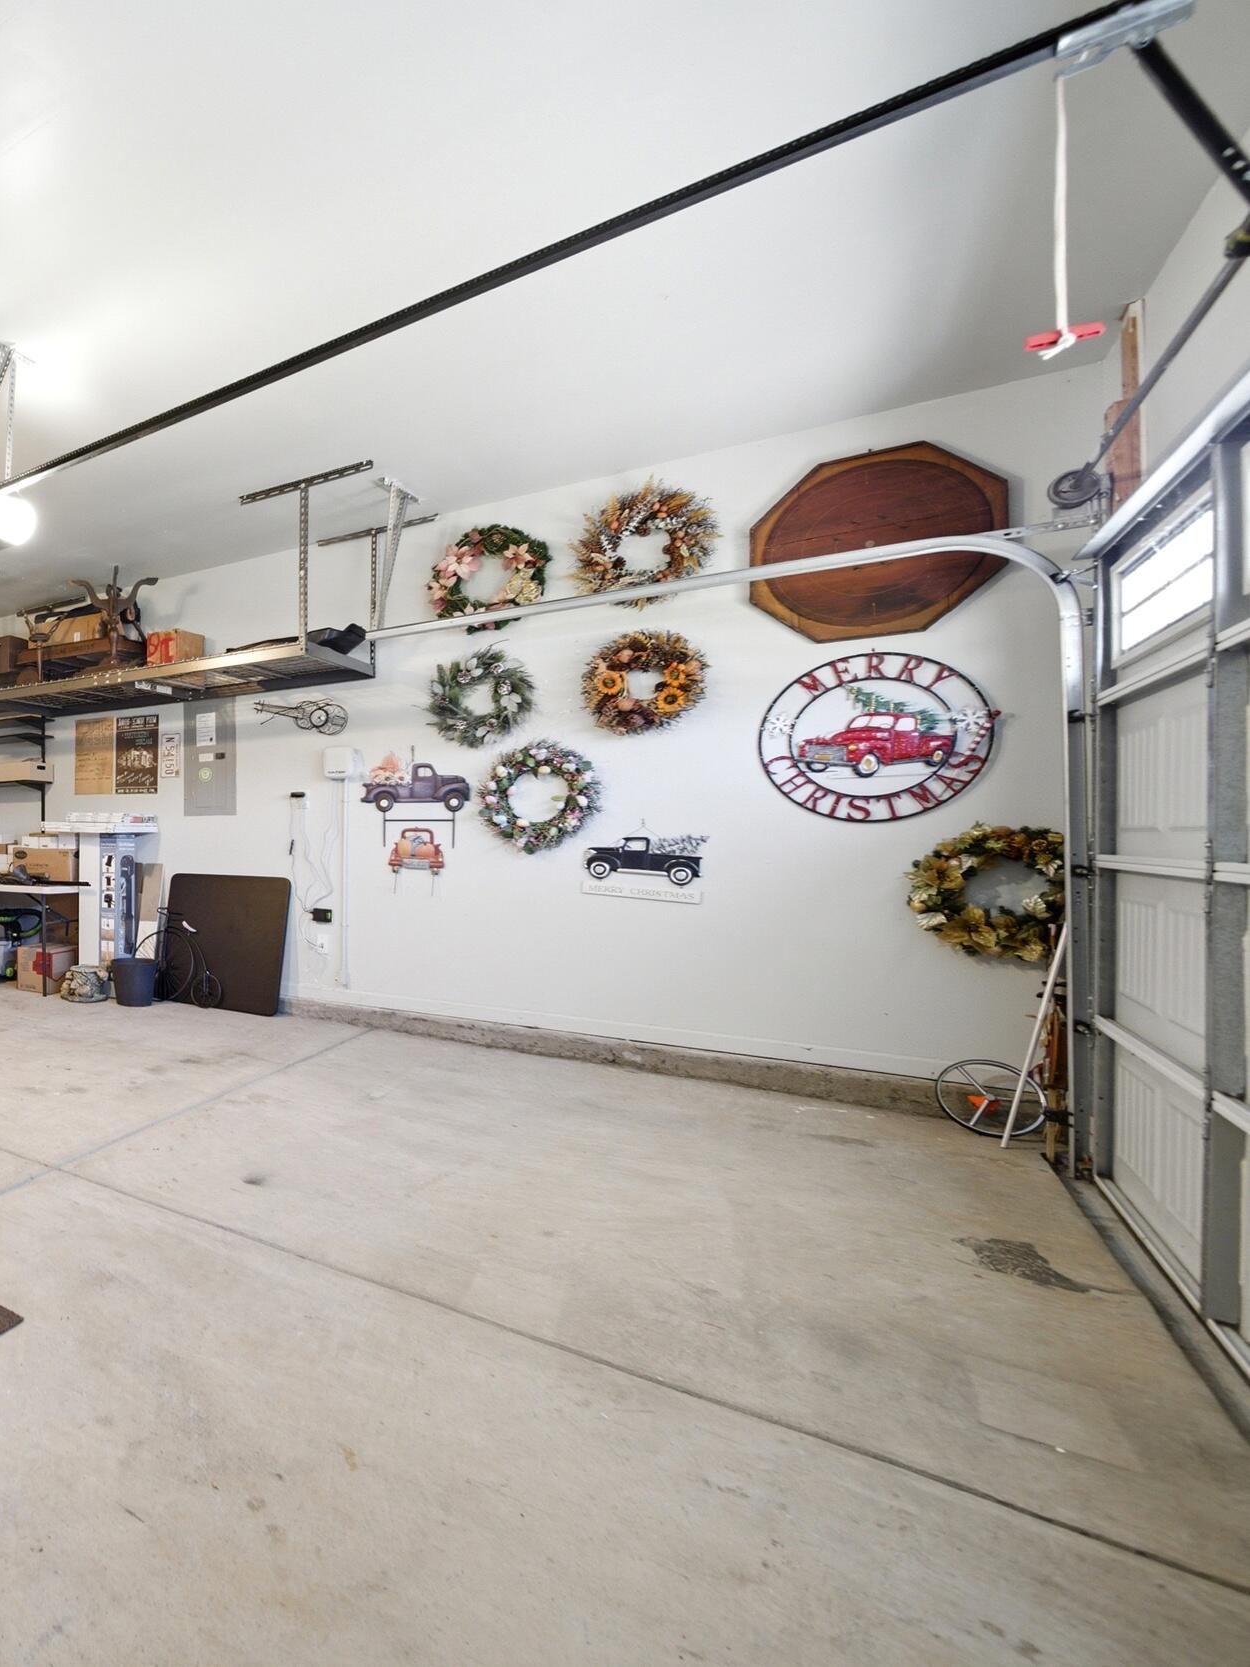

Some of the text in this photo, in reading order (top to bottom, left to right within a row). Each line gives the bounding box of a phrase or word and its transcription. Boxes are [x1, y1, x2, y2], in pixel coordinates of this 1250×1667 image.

[796, 653, 958, 698] MERRY
[763, 751, 984, 823] CHRISTMAS
[589, 884, 695, 900] MERRY CHRISTMAS
